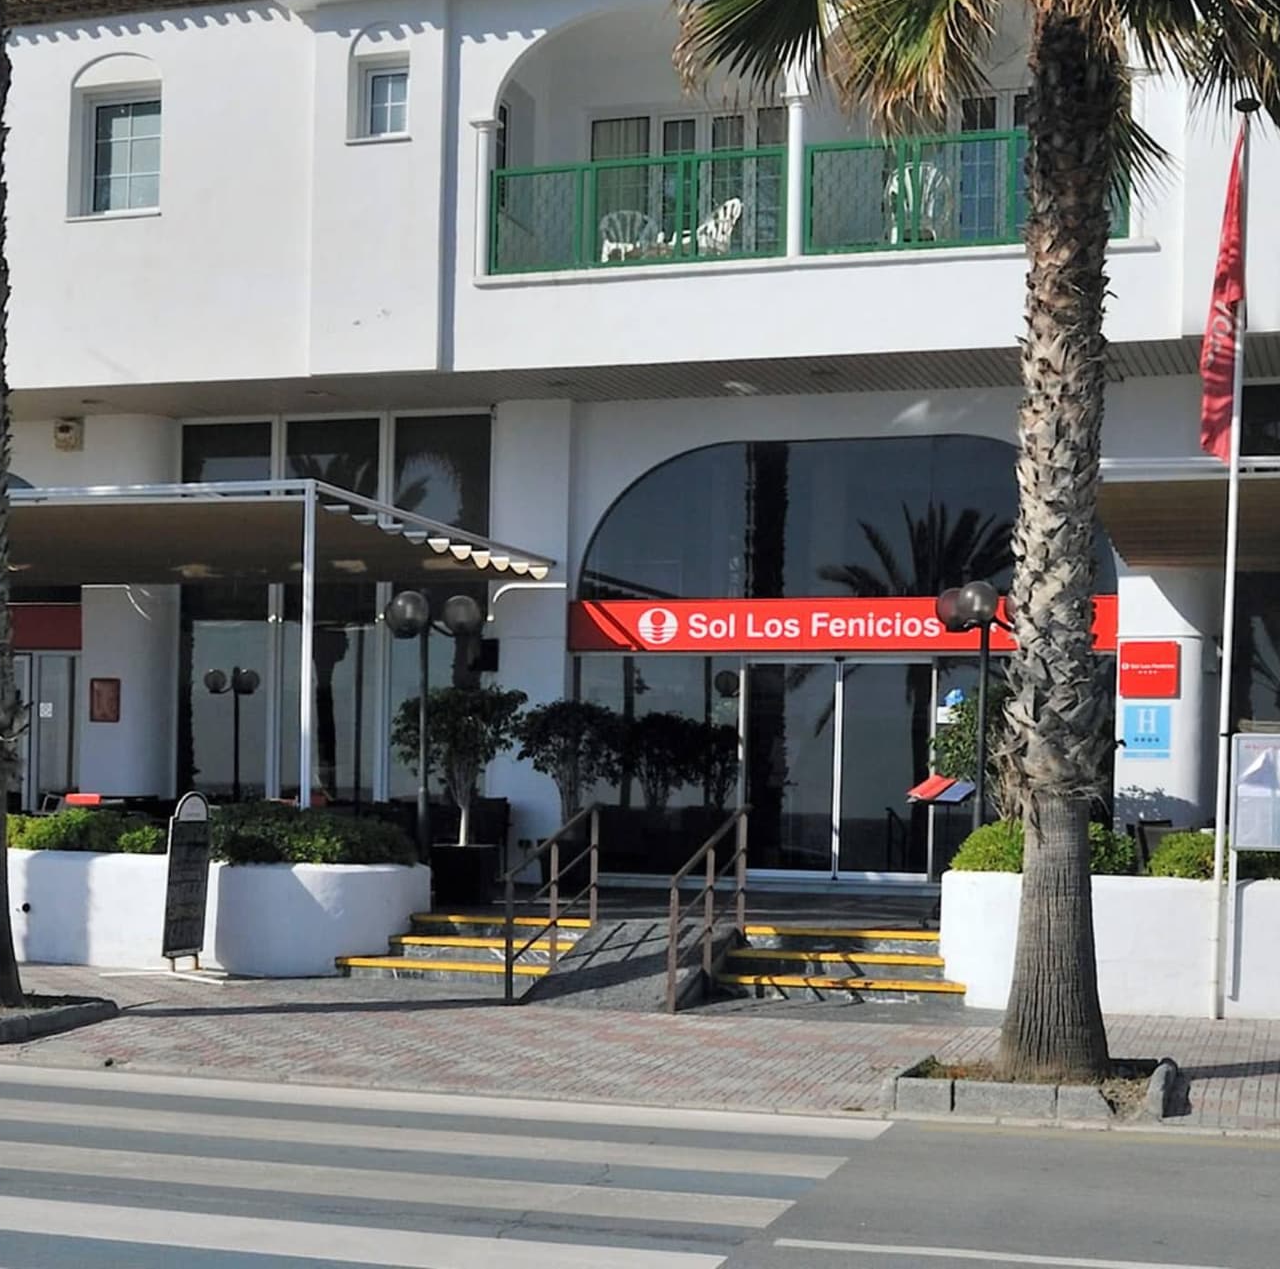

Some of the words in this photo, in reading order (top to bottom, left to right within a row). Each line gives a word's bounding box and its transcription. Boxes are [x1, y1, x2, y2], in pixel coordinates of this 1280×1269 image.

[688, 613, 735, 639] Sol
[746, 613, 800, 638] Los
[811, 612, 940, 638] Fenicios
[1136, 708, 1157, 734] H
